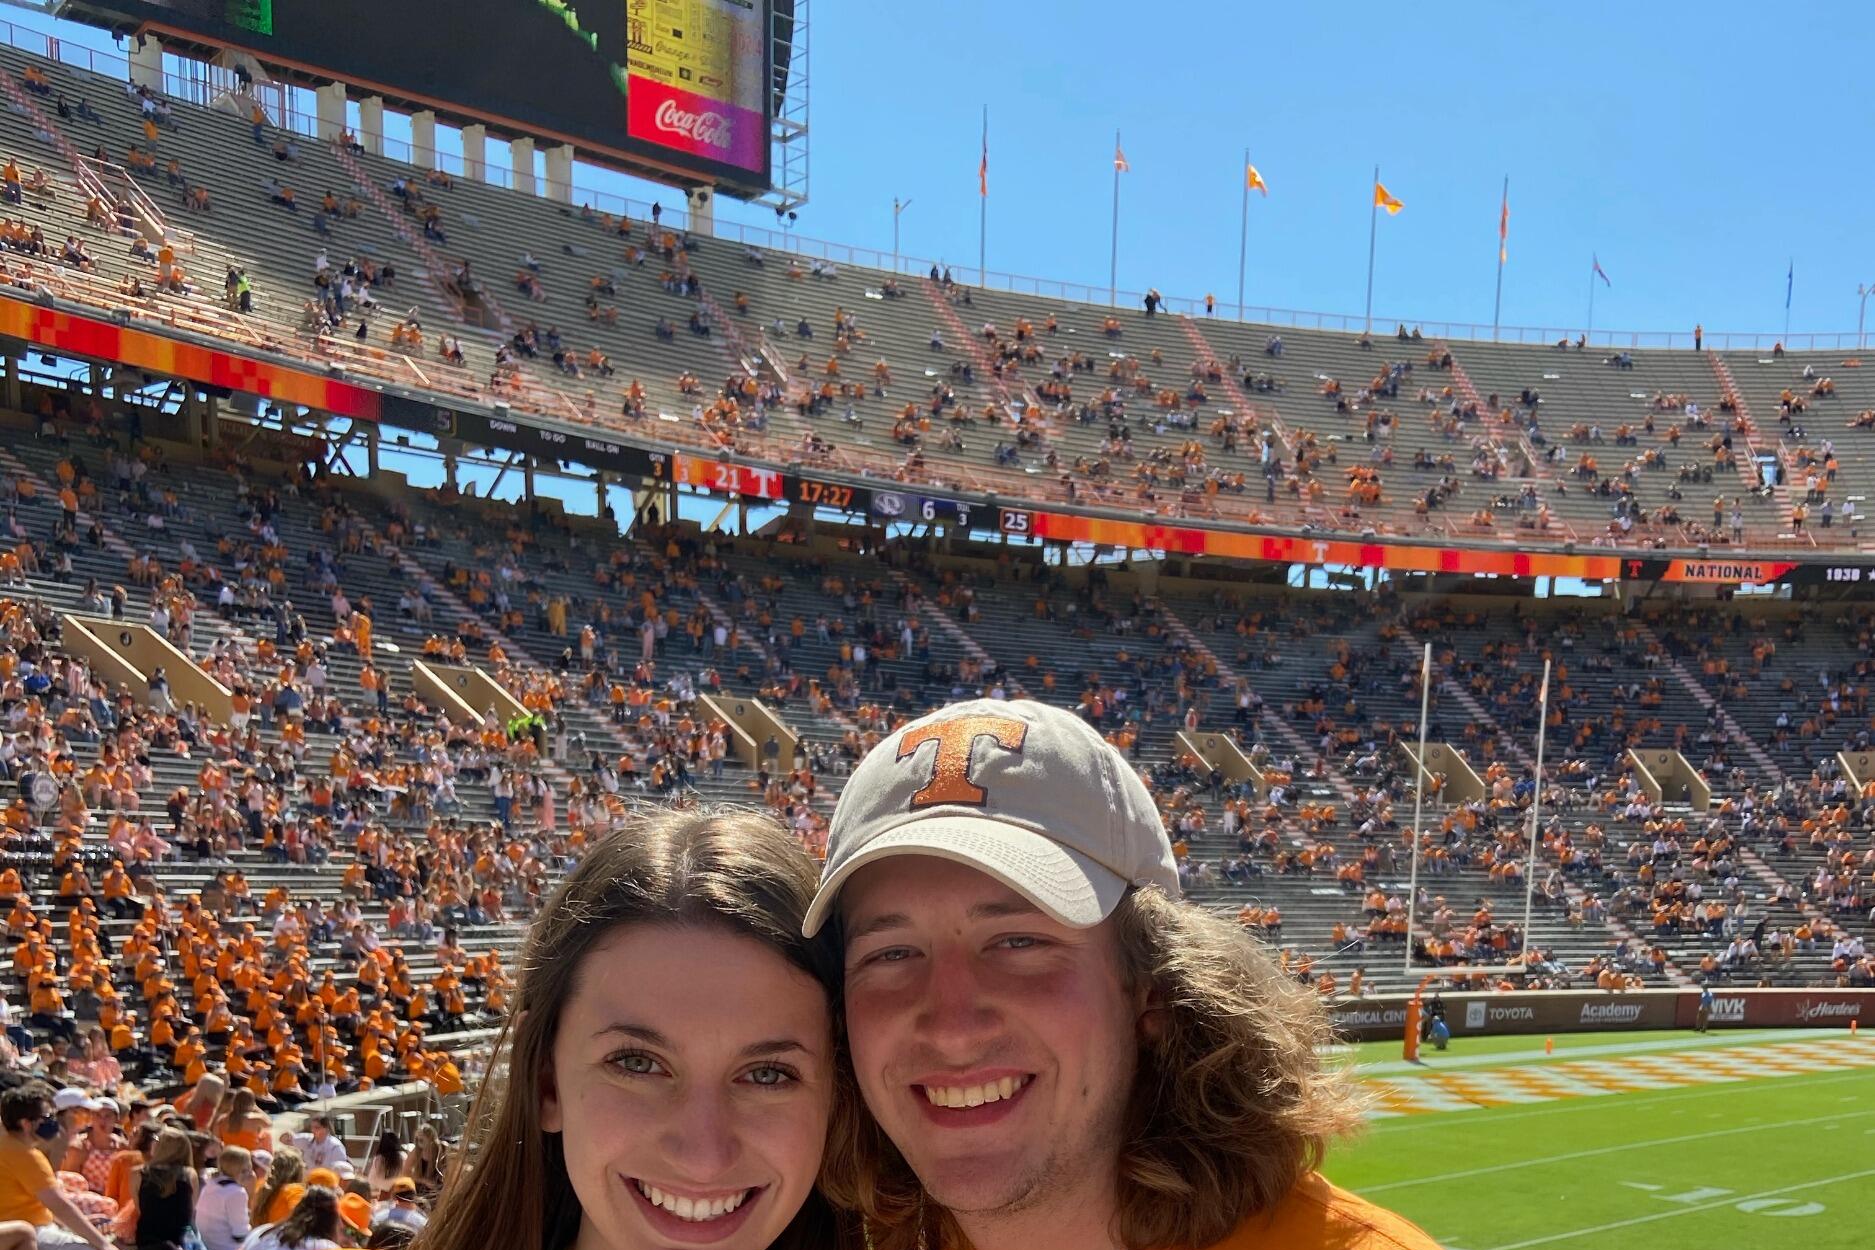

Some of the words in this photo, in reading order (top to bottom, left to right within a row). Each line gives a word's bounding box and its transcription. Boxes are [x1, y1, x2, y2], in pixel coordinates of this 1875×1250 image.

[489, 420, 517, 434] DOWN
[715, 465, 740, 490] 21
[800, 481, 853, 507] 17:27
[922, 501, 936, 520] 6
[959, 513, 968, 526] 3
[1004, 512, 1029, 531] 25
[1685, 563, 1763, 580] NATIONAL
[895, 713, 1029, 811] T
[1383, 1009, 1407, 1023] CENT
[1489, 1007, 1535, 1020] TOYOTA
[1580, 1002, 1643, 1022] Academy
